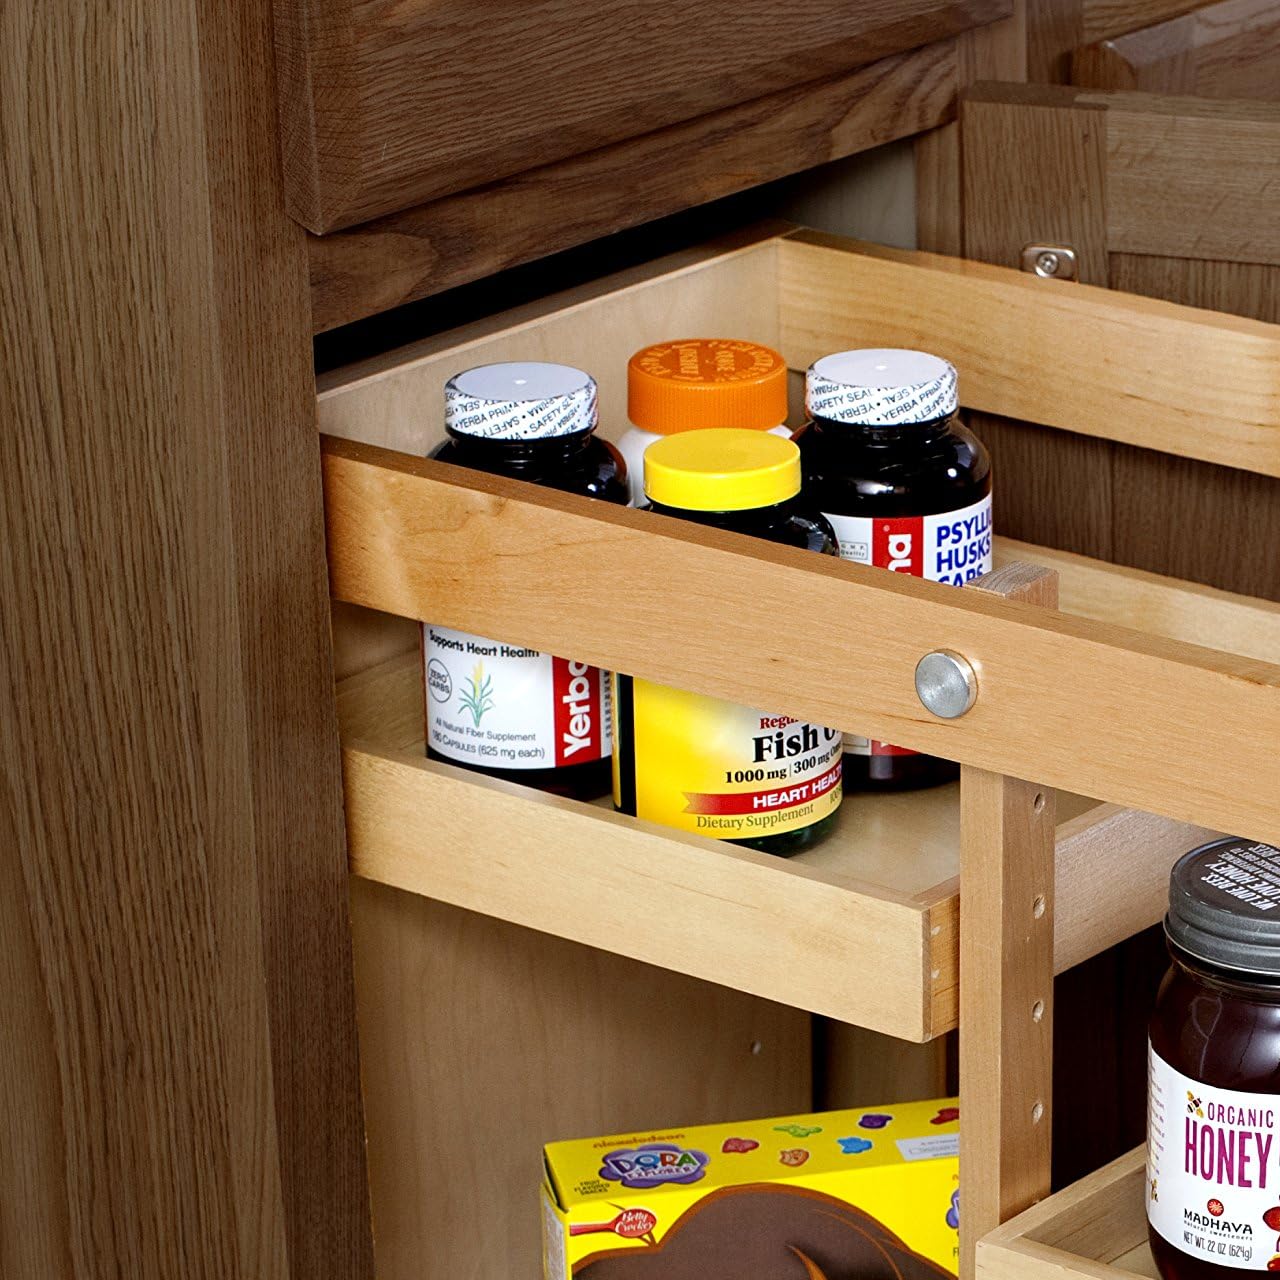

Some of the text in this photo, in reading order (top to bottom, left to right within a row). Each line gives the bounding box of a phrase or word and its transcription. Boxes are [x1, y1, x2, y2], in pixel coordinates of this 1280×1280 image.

[814, 394, 844, 411] SAFETY
[840, 403, 875, 420] YERBA
[881, 400, 919, 421] YERBA
[458, 413, 487, 429] YERBA
[529, 407, 561, 433] SAFETY
[936, 532, 990, 573] HUSKS
[429, 629, 464, 652] Supports
[466, 642, 498, 657] Heart
[428, 678, 450, 694] CARBS
[429, 669, 448, 684] ZERO
[443, 720, 464, 735] Natural
[466, 728, 485, 739] Fiber
[487, 730, 537, 742] Supplement
[478, 744, 498, 757] (625
[500, 747, 516, 760] mg
[518, 747, 546, 760] each)
[752, 724, 819, 763] Fish
[726, 752, 831, 784] 1000 mg 300 mg
[753, 764, 842, 809] HEART HEALT
[697, 804, 814, 831] Dietary Supplement
[1226, 886, 1260, 901] LOVE
[1251, 898, 1277, 910] WE
[1207, 1102, 1274, 1128] ORGANIC
[608, 1152, 700, 1174] DORA
[1185, 1117, 1273, 1189] HONEY
[1184, 1208, 1253, 1235] MADHAVA
[1184, 1230, 1194, 1245] NET
[1208, 1240, 1216, 1253] 22
[1217, 1242, 1227, 1255] OZ
